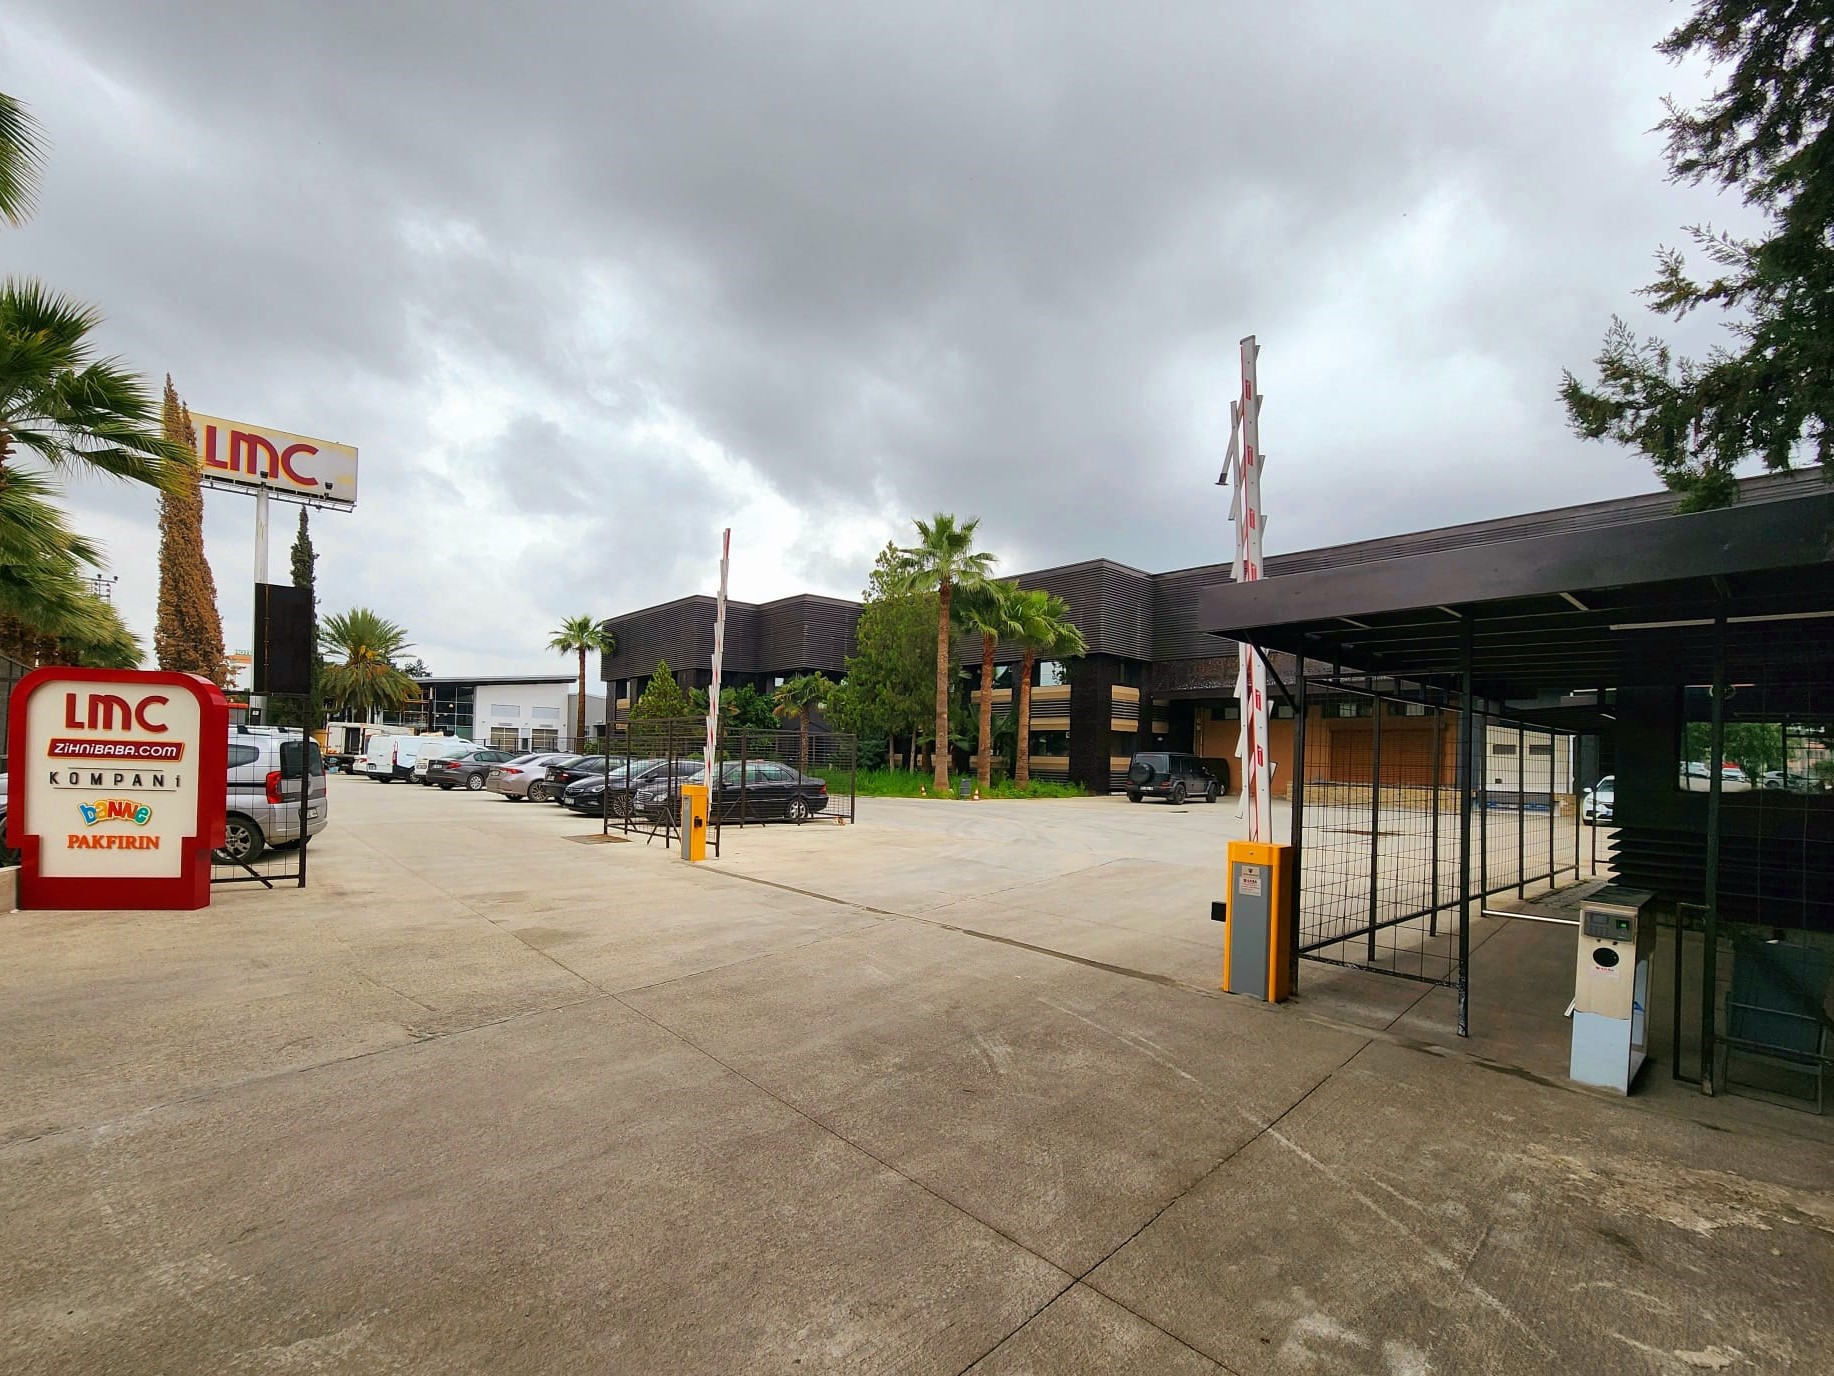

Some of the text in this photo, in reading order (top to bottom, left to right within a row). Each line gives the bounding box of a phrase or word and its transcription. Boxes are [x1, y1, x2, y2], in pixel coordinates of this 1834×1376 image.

[205, 425, 319, 486] LMC
[65, 692, 170, 733] LMC
[66, 834, 160, 849] PAKFIRIN
